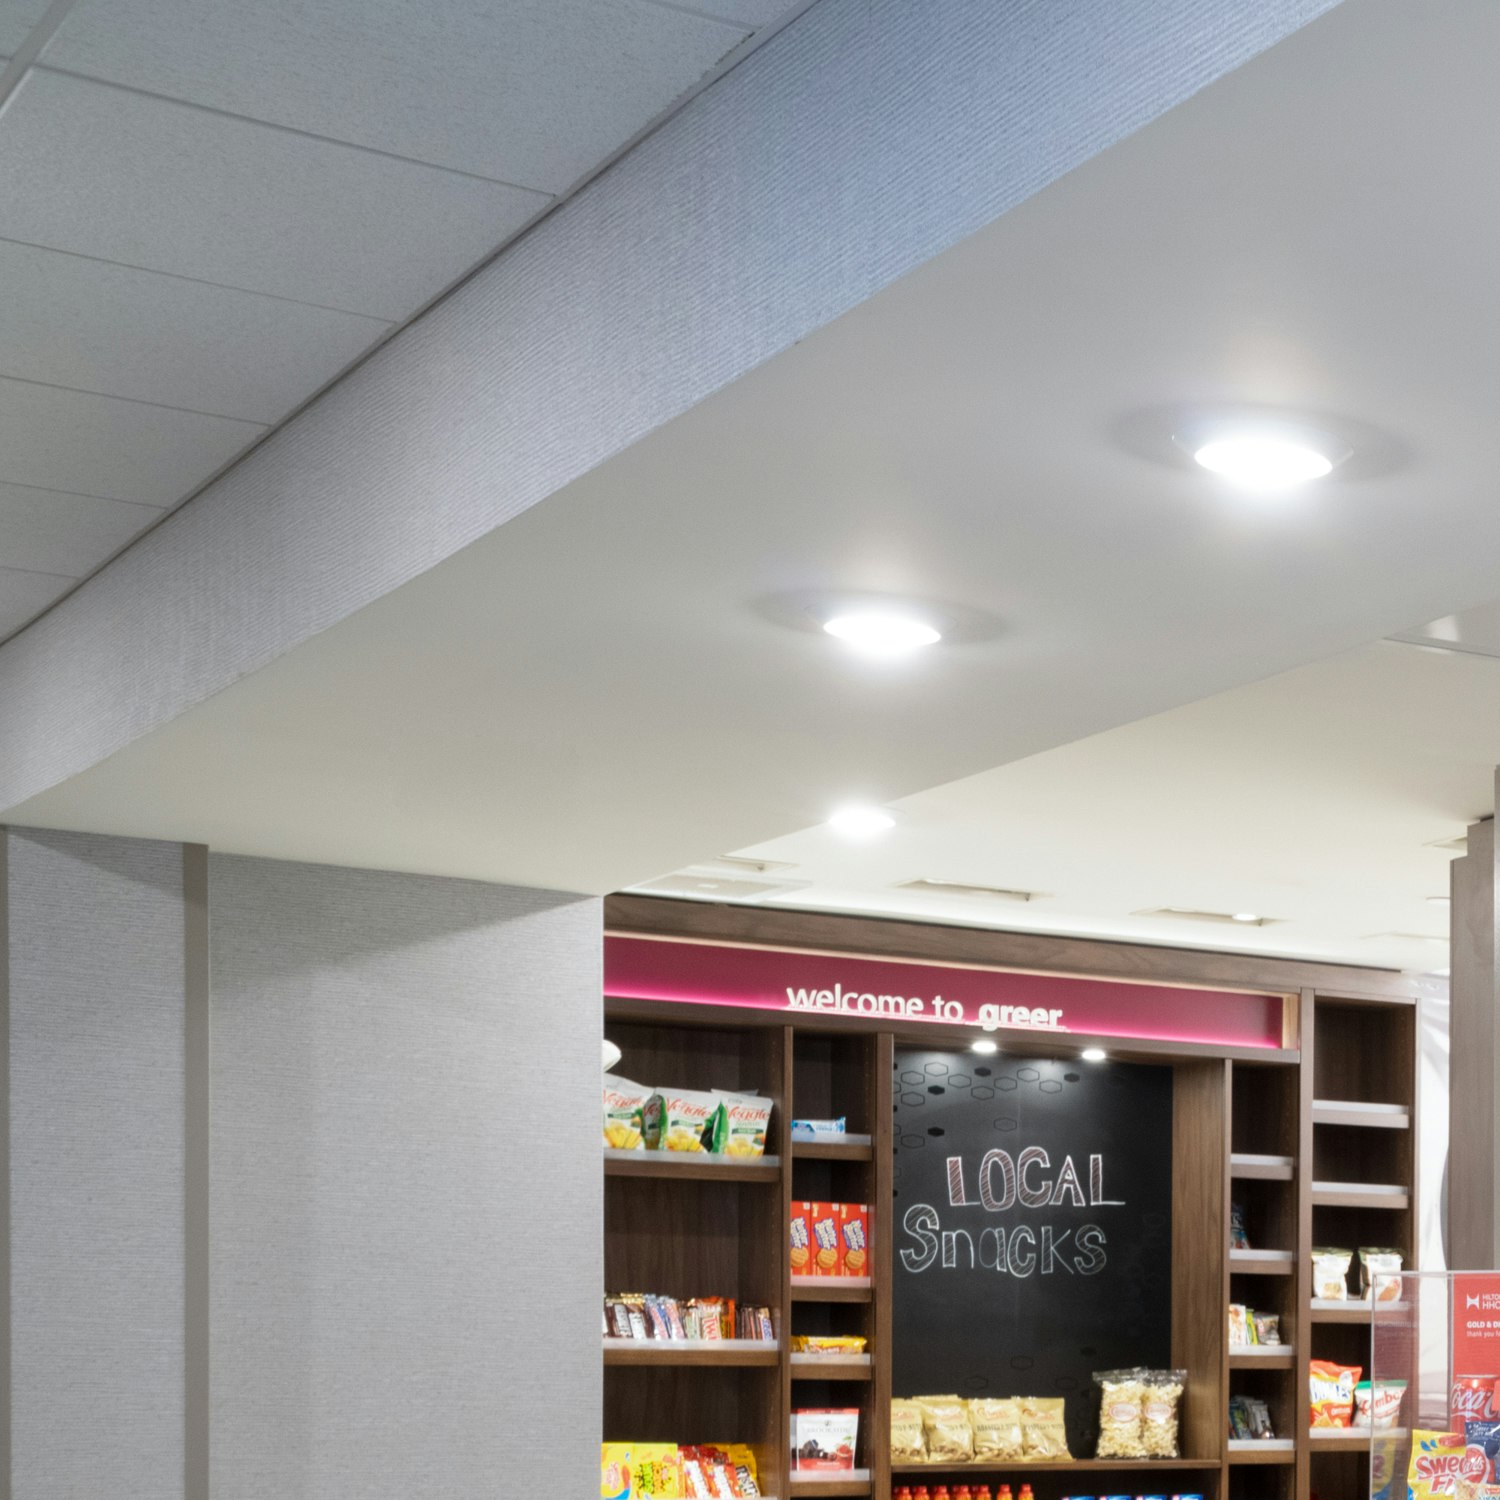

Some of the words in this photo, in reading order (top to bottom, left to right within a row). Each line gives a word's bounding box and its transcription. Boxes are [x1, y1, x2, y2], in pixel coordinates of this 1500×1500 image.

[786, 983, 924, 1017] welcome
[932, 995, 964, 1021] to
[978, 1003, 1063, 1031] greer
[946, 1146, 1126, 1211] LOCAL
[900, 1204, 1107, 1278] Snacks
